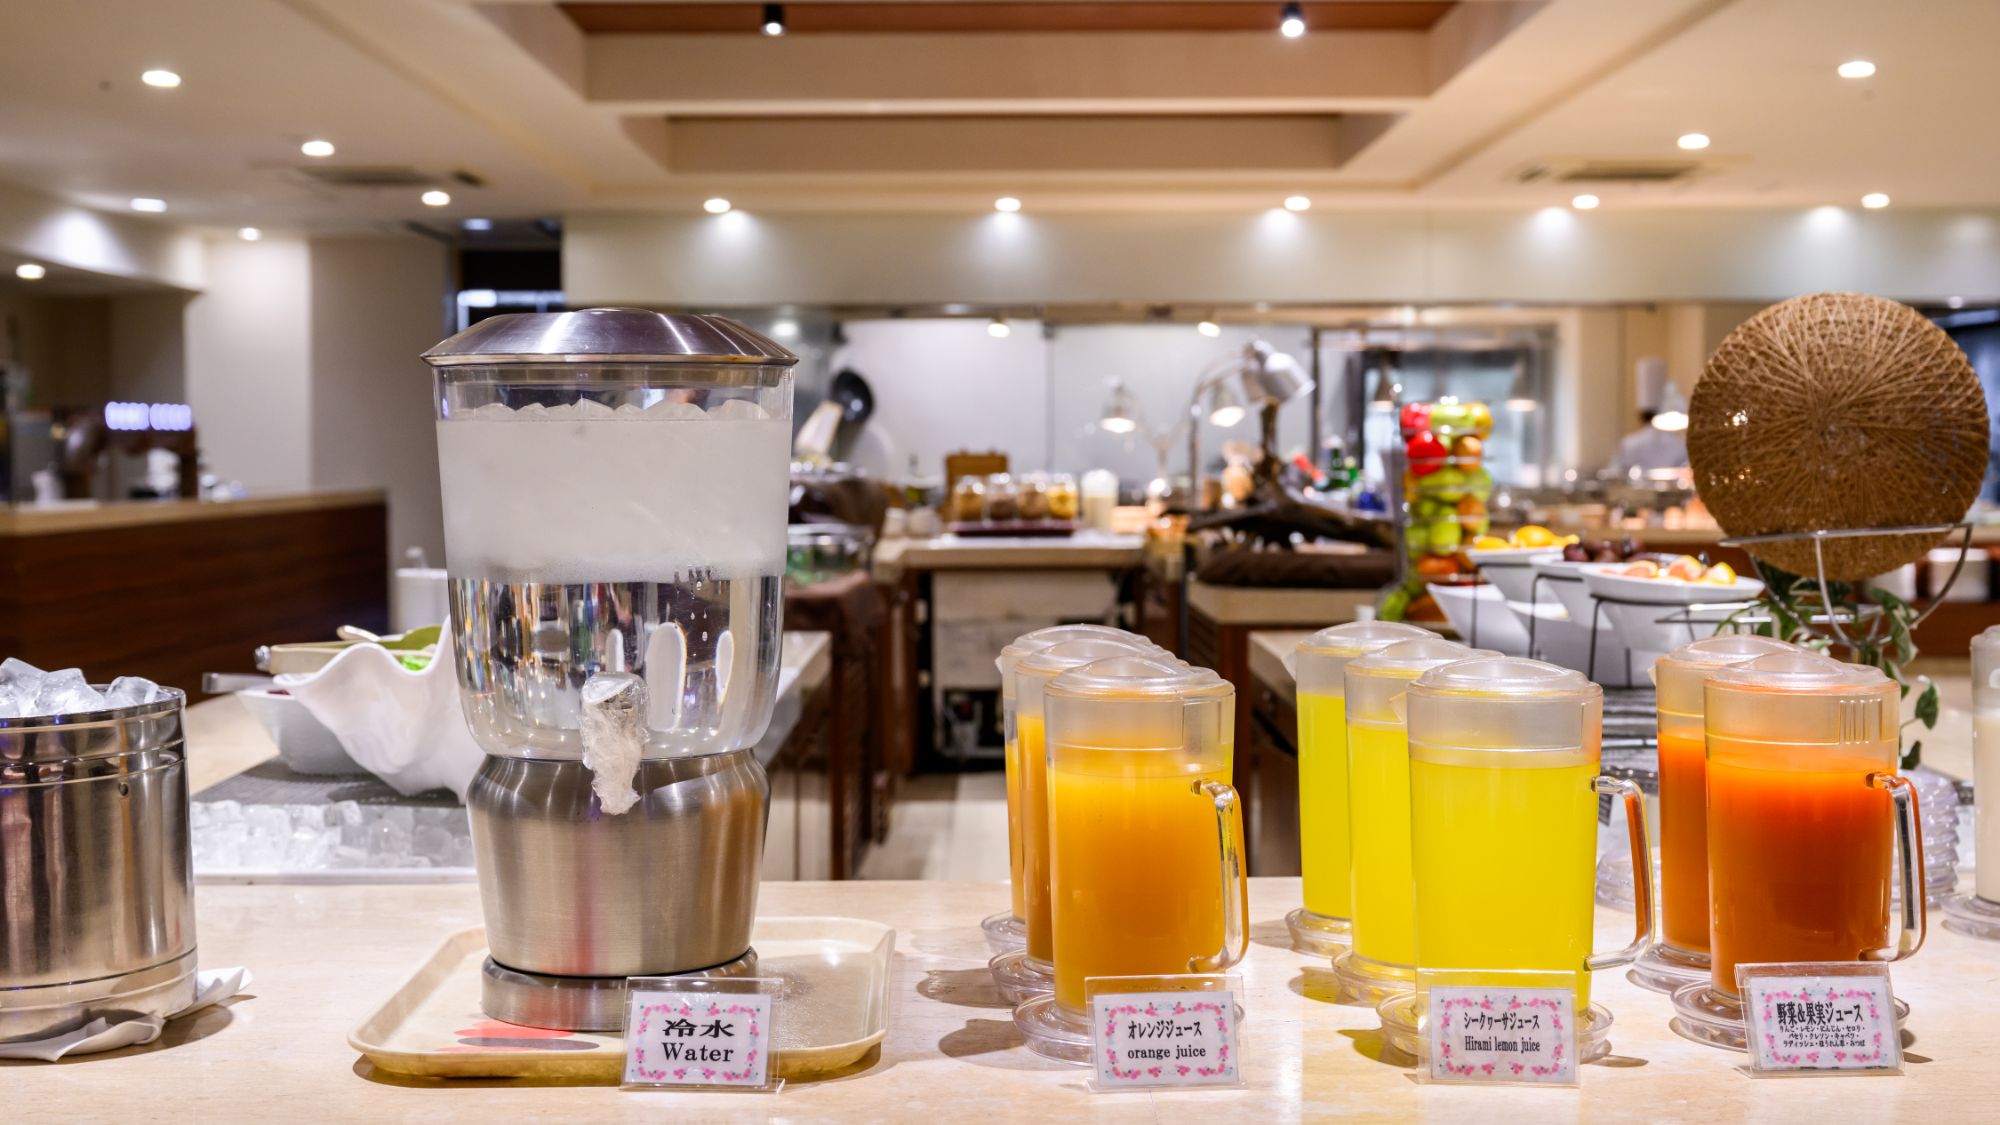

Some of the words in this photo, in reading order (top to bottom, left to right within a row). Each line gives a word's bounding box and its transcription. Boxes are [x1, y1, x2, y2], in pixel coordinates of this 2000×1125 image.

[1776, 1001, 1863, 1026] 野菜&果実ジュース
[662, 1018, 735, 1039] 冷水
[1128, 1019, 1203, 1041] オレンジジュース
[661, 1042, 734, 1062] Water
[1127, 1049, 1171, 1060] orange
[1175, 1045, 1207, 1060] juice
[1464, 1035, 1492, 1051] Hirami
[1494, 1036, 1518, 1052] lemon
[1521, 1037, 1541, 1054] juice
